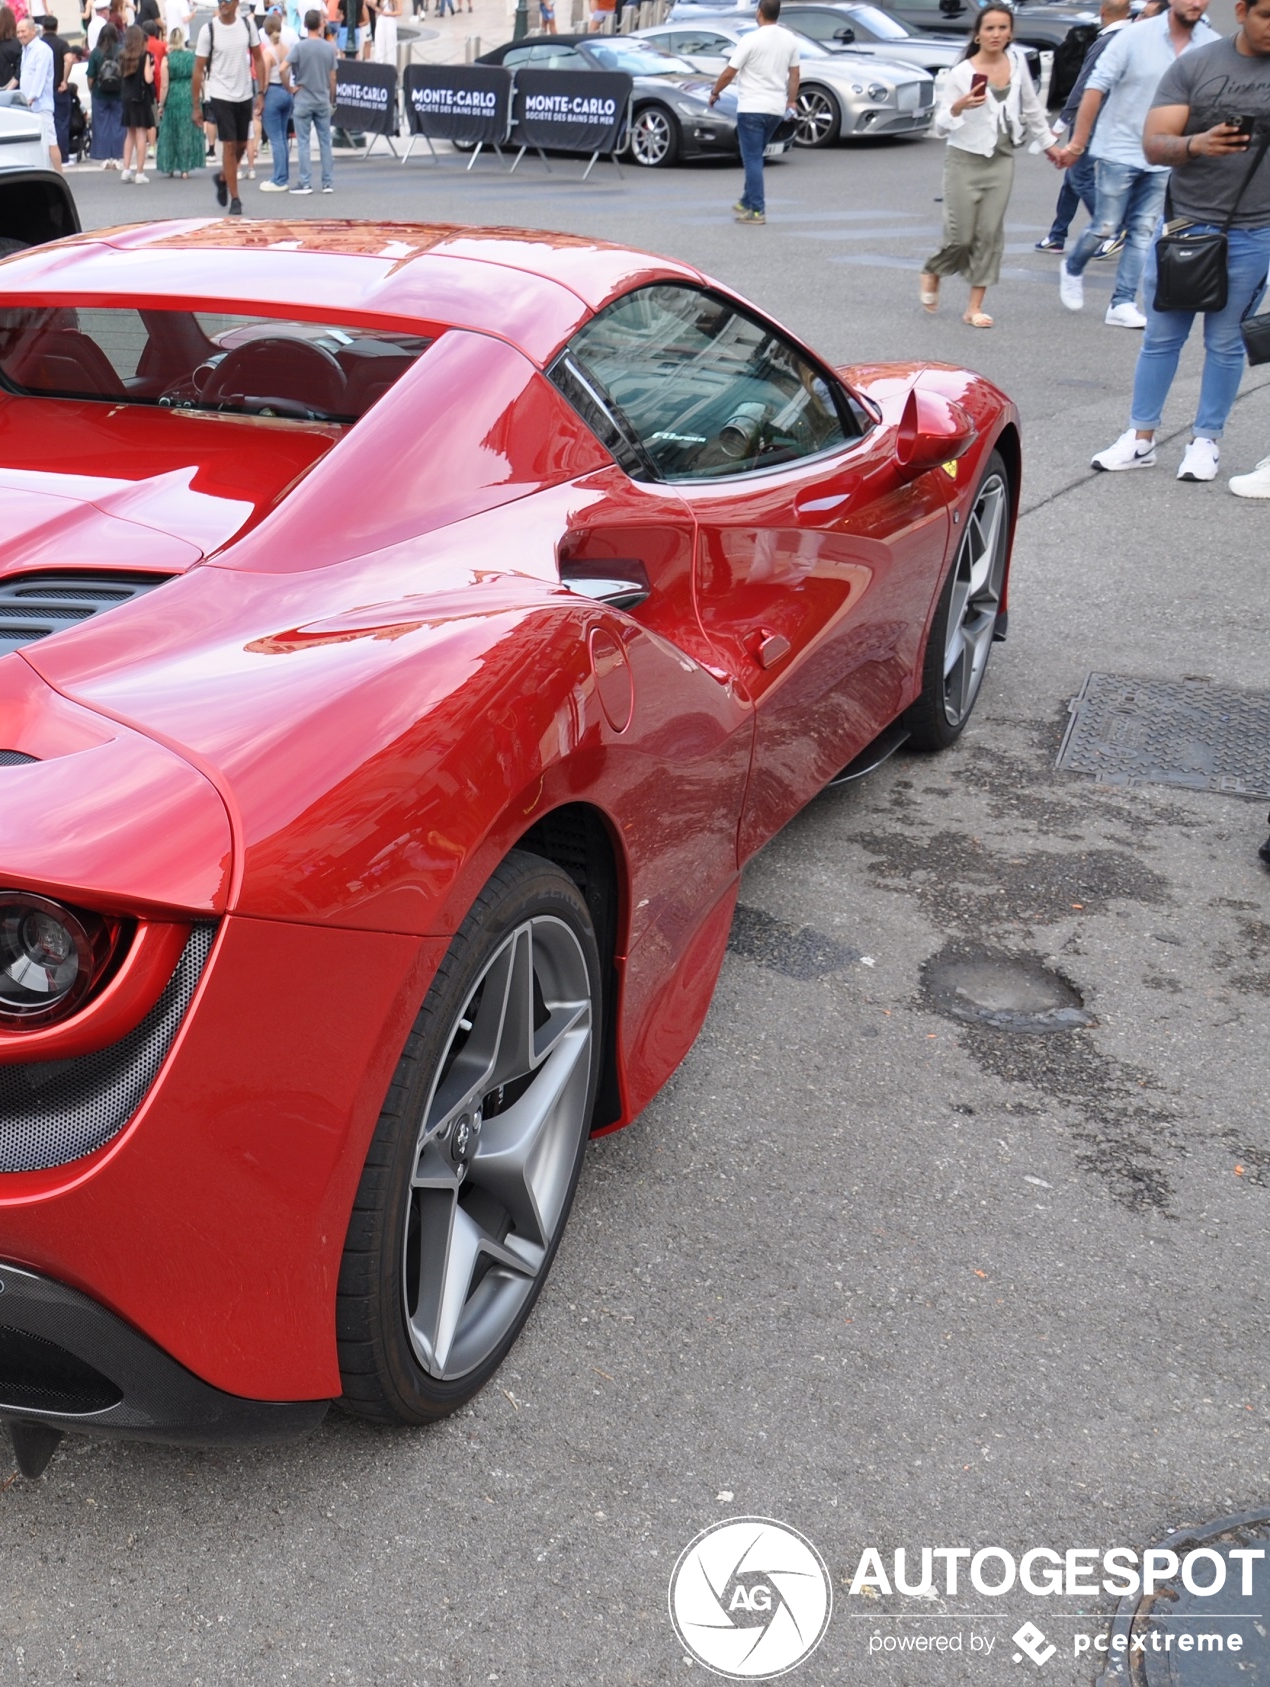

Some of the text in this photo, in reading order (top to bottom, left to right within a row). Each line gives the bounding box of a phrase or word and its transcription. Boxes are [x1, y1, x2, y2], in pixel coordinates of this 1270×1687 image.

[553, 112, 567, 122] DES
[567, 113, 587, 123] BAINS
[588, 115, 599, 124] DE
[600, 115, 614, 125] MER
